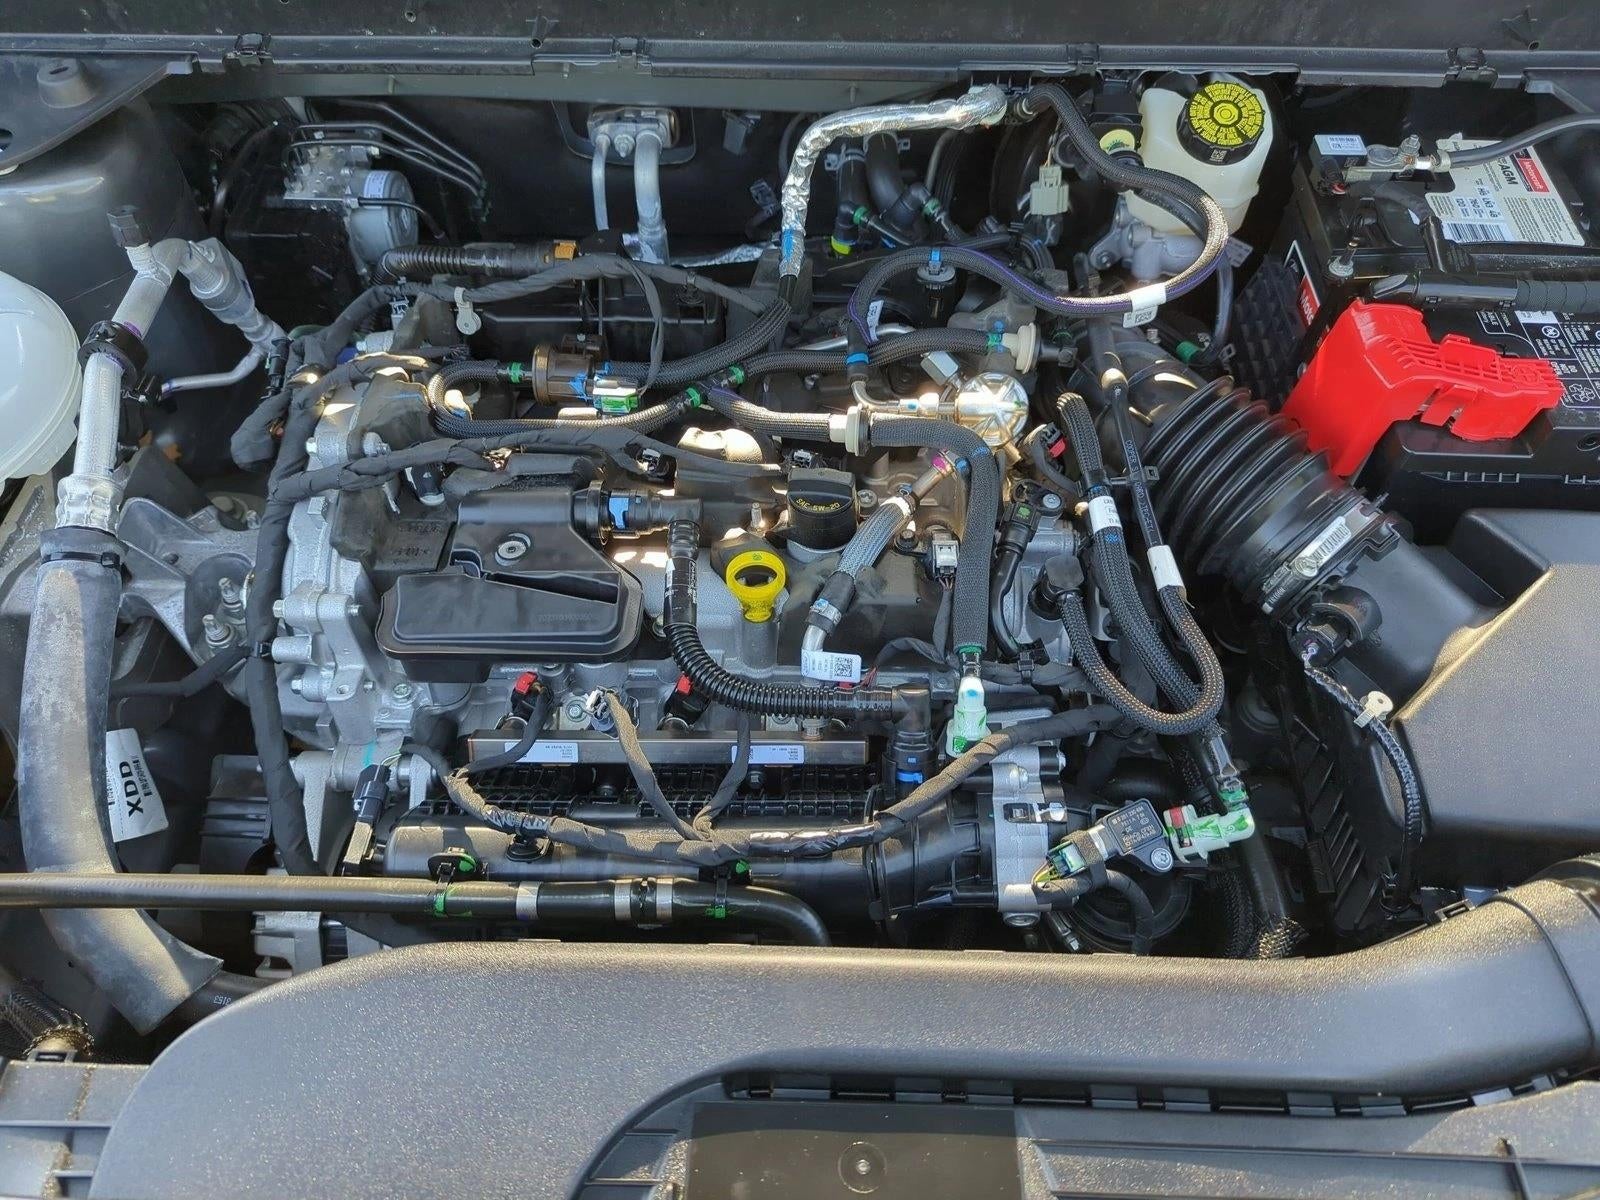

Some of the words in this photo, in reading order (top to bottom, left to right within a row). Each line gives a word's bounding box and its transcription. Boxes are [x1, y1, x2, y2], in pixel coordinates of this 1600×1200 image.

[1498, 164, 1518, 184] AGM
[1524, 161, 1544, 190] Motorcraft
[1126, 440, 1136, 464] COOPER
[796, 498, 810, 508] SAE
[813, 502, 840, 511] 5W-20
[119, 762, 144, 818] XDD
